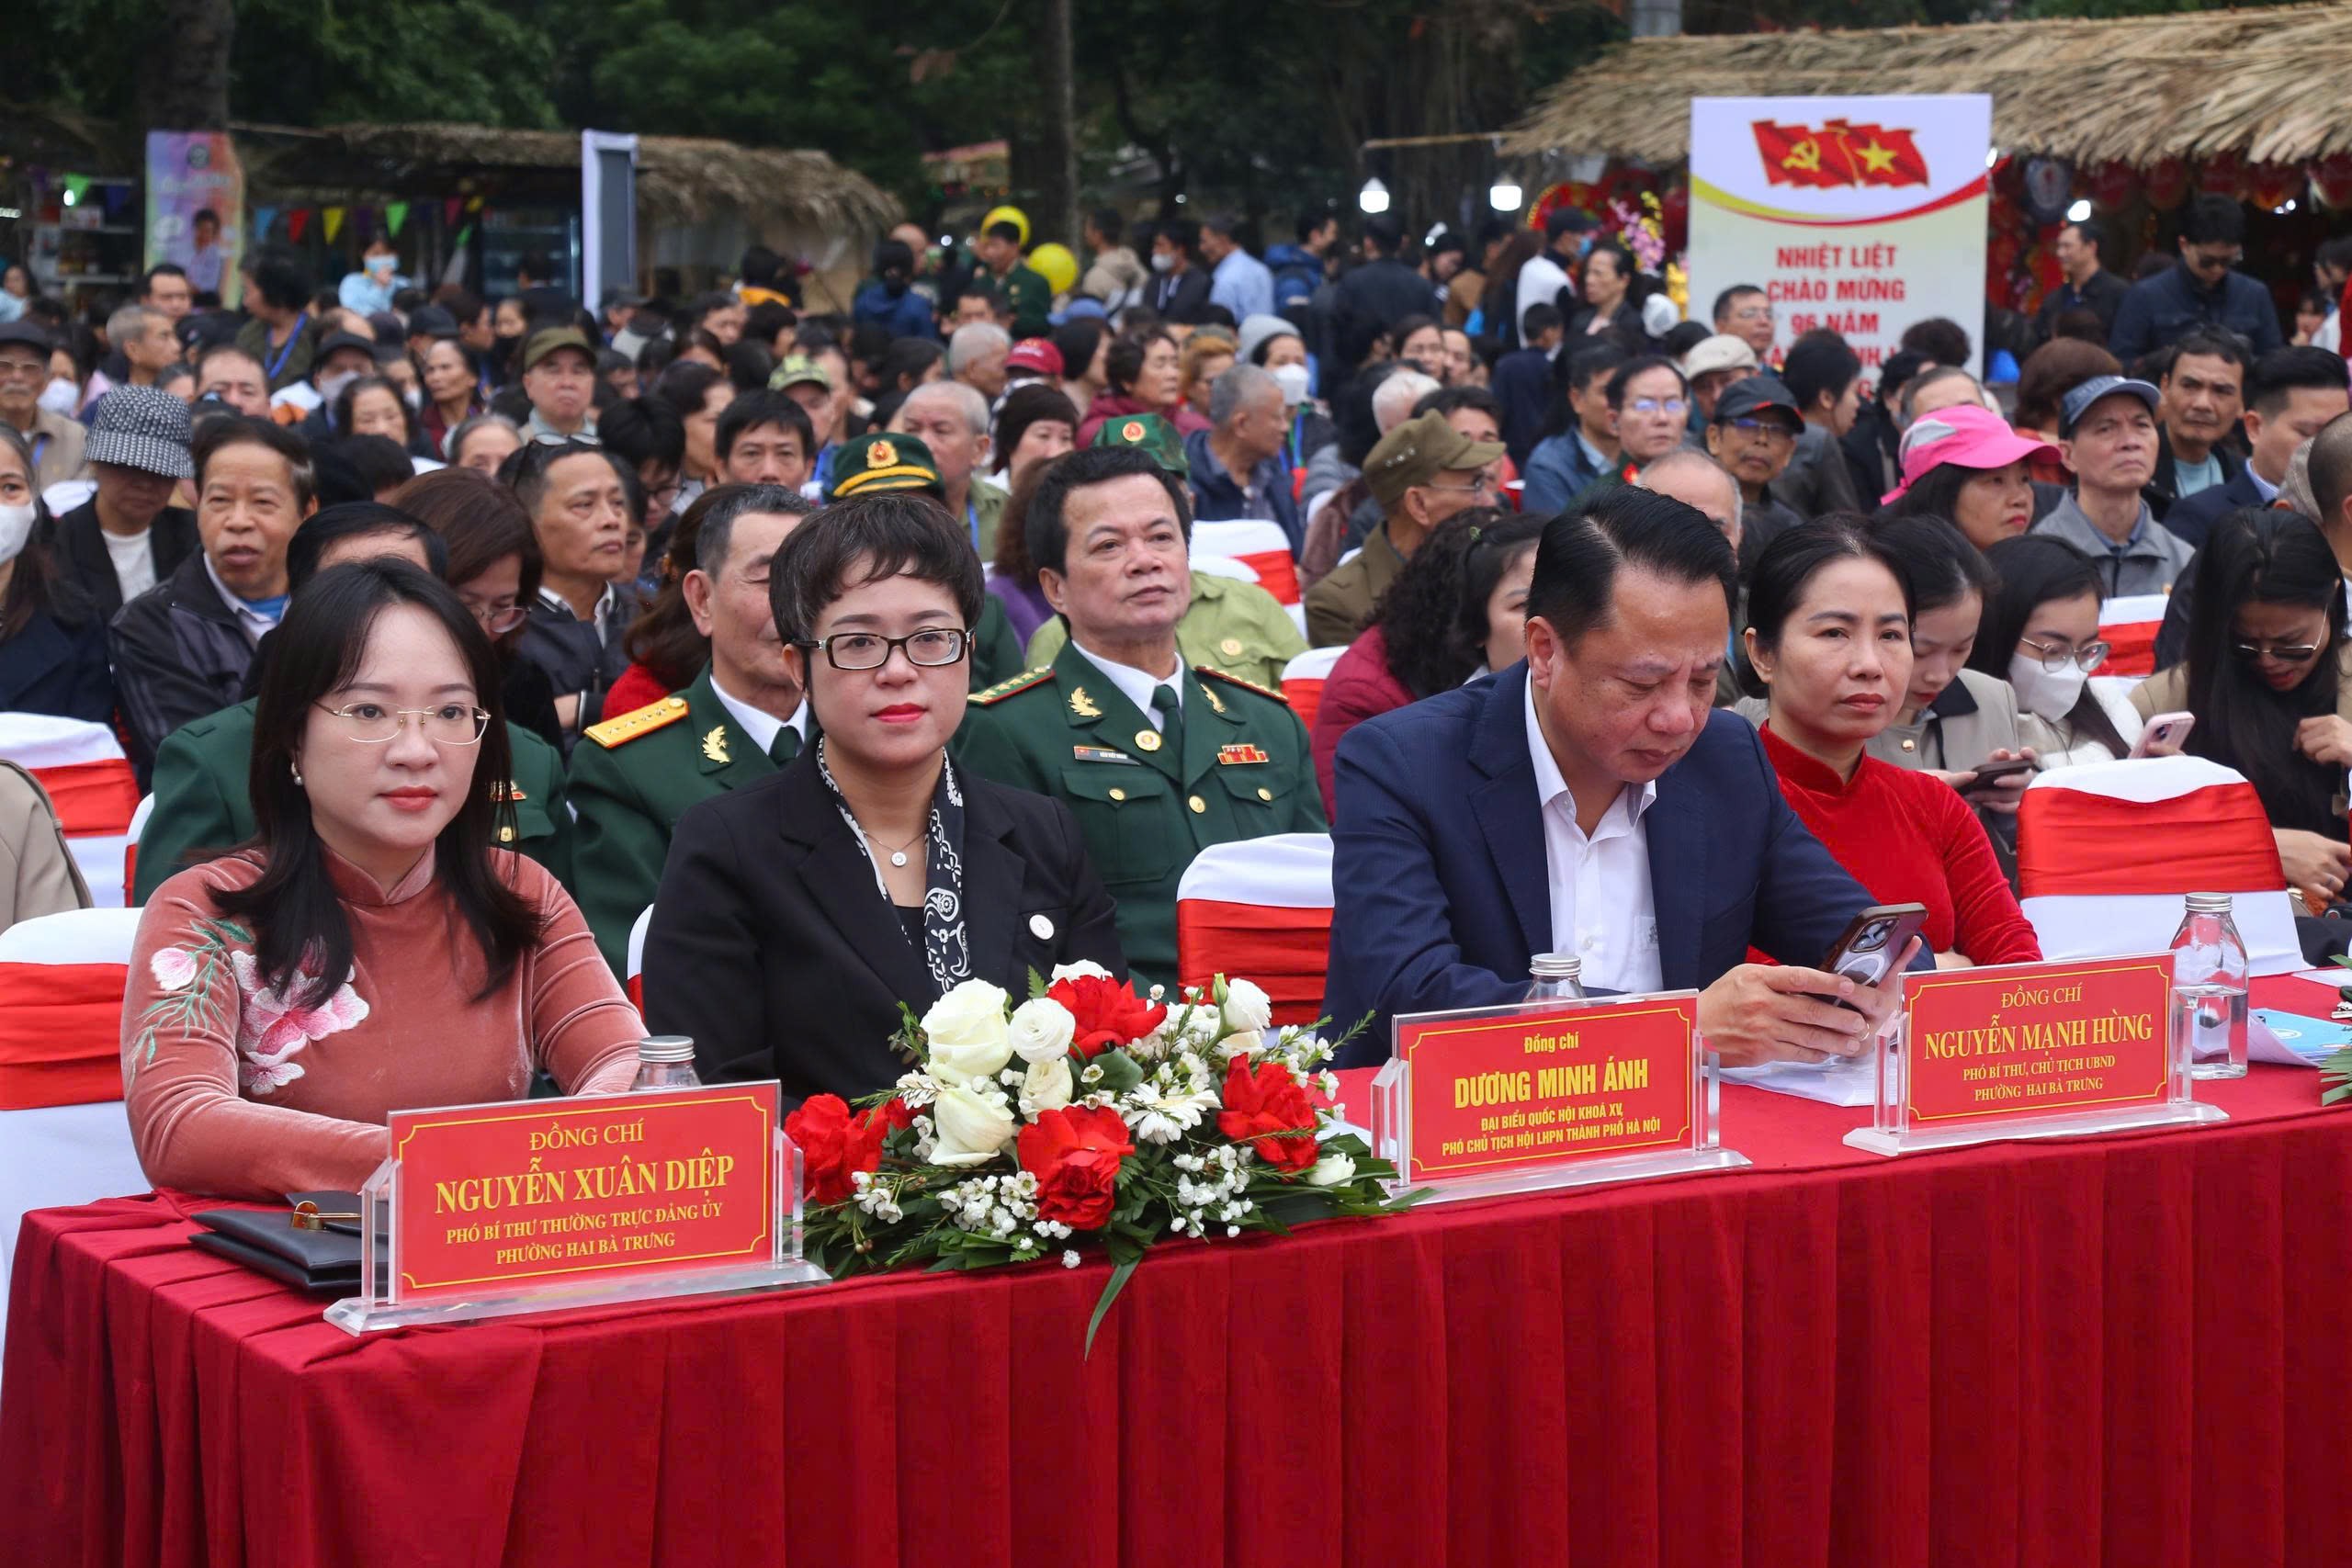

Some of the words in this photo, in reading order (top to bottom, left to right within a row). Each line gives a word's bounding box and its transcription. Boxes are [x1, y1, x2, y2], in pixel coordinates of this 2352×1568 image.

[1777, 243, 1841, 270] NHIỆT
[1851, 242, 1896, 270] LIỆT
[1767, 277, 1827, 301] CHÀO
[1836, 277, 1905, 301] MỪNG
[2001, 985, 2049, 1009] ĐỒNG
[2052, 982, 2082, 1002] CHÍ
[1523, 1032, 1555, 1054] Đồng
[1559, 1031, 1579, 1050] chí
[1924, 1014, 2018, 1060] NGUYỄN
[2021, 1021, 2086, 1056] MẠNH
[2092, 1009, 2154, 1044] HÙNG
[1454, 1070, 1531, 1109] DƯƠNG
[1538, 1066, 1596, 1099] MINH
[1602, 1055, 1648, 1091] ÁNH
[1962, 1063, 1986, 1081] PHÓ
[1989, 1062, 2000, 1079] BÍ
[2003, 1060, 2029, 1077] THƯ,
[2030, 1057, 2054, 1074] CHỦ
[2056, 1057, 2084, 1076] TỊCH
[2086, 1055, 2115, 1069] UBND
[1974, 1083, 2021, 1102] PHƯỜNG
[2027, 1082, 2047, 1096] HAI
[2049, 1077, 2064, 1094] BÀ
[2065, 1077, 2103, 1092] TRƯNG
[1481, 1117, 1498, 1132] ĐẠI
[1502, 1109, 1526, 1129] BIỂU
[1528, 1106, 1556, 1126] QUỐC
[1558, 1109, 1576, 1124] HỘI
[530, 1122, 598, 1151] ĐỒNG
[603, 1118, 644, 1145] CHÍ
[1442, 1139, 1464, 1156] PHÓ
[1466, 1135, 1488, 1153] CHỦ
[1491, 1135, 1514, 1152] TỊCH
[1517, 1132, 1534, 1148] HỘI
[1537, 1128, 1563, 1145] LHPN
[1566, 1122, 1600, 1141] THÀNH
[1603, 1118, 1623, 1137] PHỐ
[1626, 1118, 1640, 1134] HÀ
[1643, 1118, 1660, 1133] NỘI
[435, 1156, 566, 1213] NGUYỄN
[573, 1156, 658, 1201] XUÂN
[665, 1147, 733, 1197] DIỆP
[447, 1223, 481, 1244] PHÓ
[485, 1221, 501, 1241] BÍ
[505, 1219, 537, 1237] THƯ
[540, 1213, 606, 1235] THƯỜNG
[610, 1208, 653, 1231] TRỰC
[656, 1202, 698, 1224] ĐẢNG
[702, 1200, 722, 1219] ỦY
[496, 1240, 562, 1265] PHƯỜNG
[566, 1239, 595, 1257] HAI
[598, 1235, 618, 1254] BÀ
[622, 1232, 675, 1252] TRƯNG
